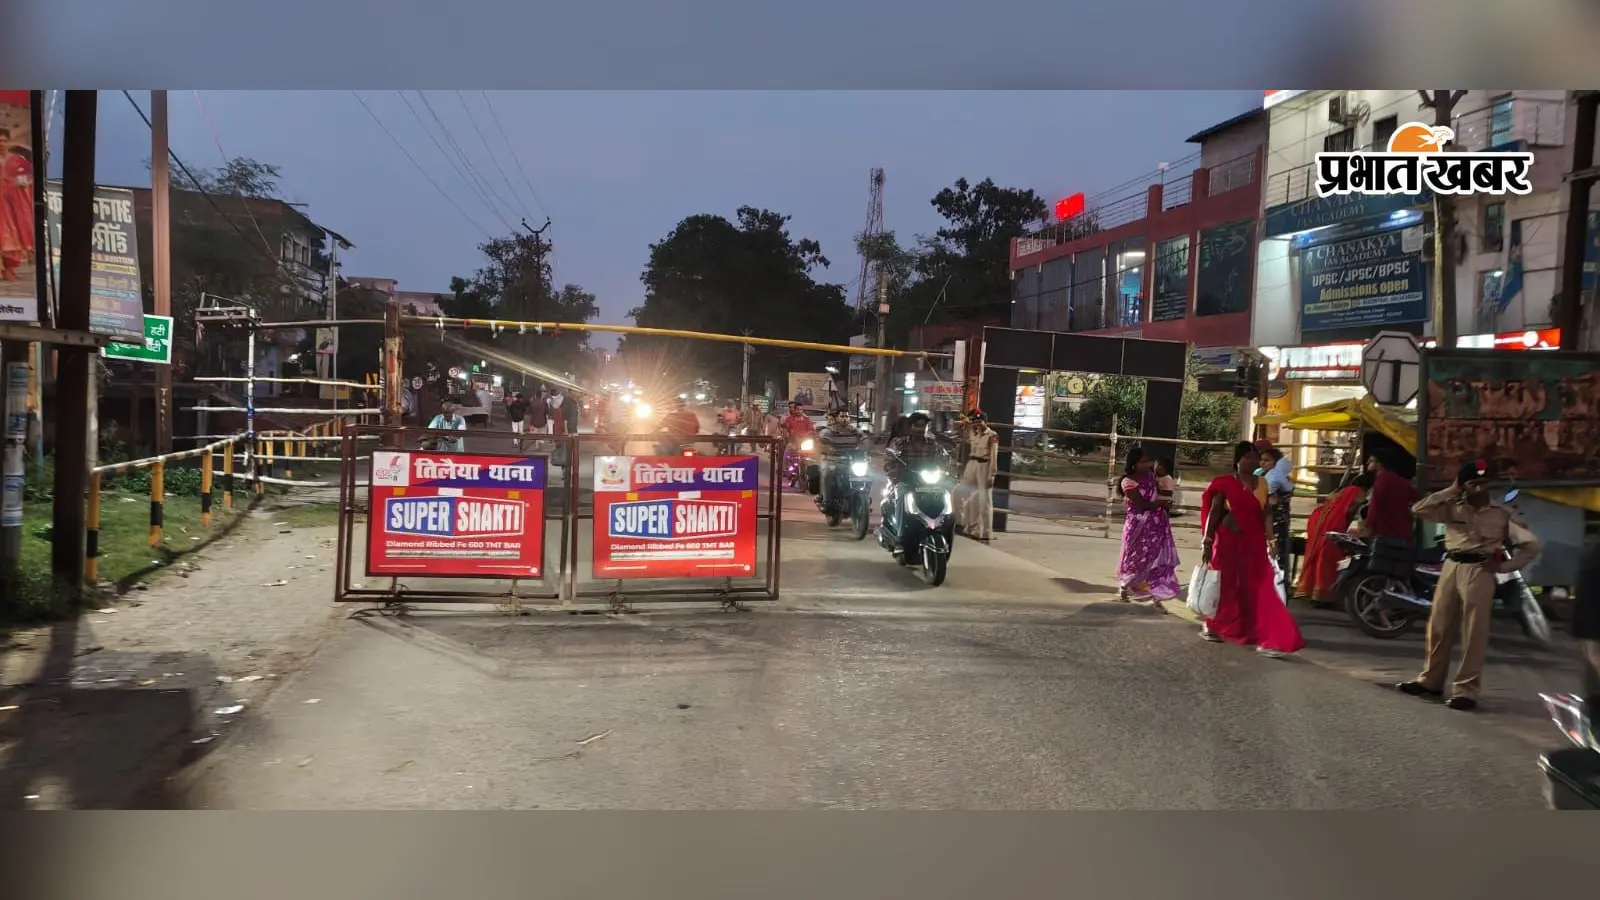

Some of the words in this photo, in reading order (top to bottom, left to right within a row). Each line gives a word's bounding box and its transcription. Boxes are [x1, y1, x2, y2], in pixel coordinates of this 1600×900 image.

[1314, 203, 1367, 225] ACADEMY
[1315, 235, 1397, 260] CHANAKYA
[1340, 250, 1388, 265] ACADEMY
[1312, 260, 1410, 288] UPSC/JPSC/BPSC
[1319, 282, 1378, 302] Admissions
[1380, 278, 1409, 294] open
[414, 458, 481, 480] तिलैया
[488, 464, 535, 482] थाना
[634, 462, 696, 484] तिलैया
[702, 467, 745, 483] थाना
[391, 501, 450, 532] SUPER
[457, 501, 520, 532] SHAKTI
[614, 504, 669, 535] SUPER
[675, 504, 733, 534] SHAKTI
[386, 541, 425, 549] Diamond
[426, 541, 456, 549] Ribbed
[485, 541, 502, 549] TMT
[610, 543, 646, 551] Diamond
[647, 542, 674, 550] Ribbed
[718, 541, 735, 549] BAR
